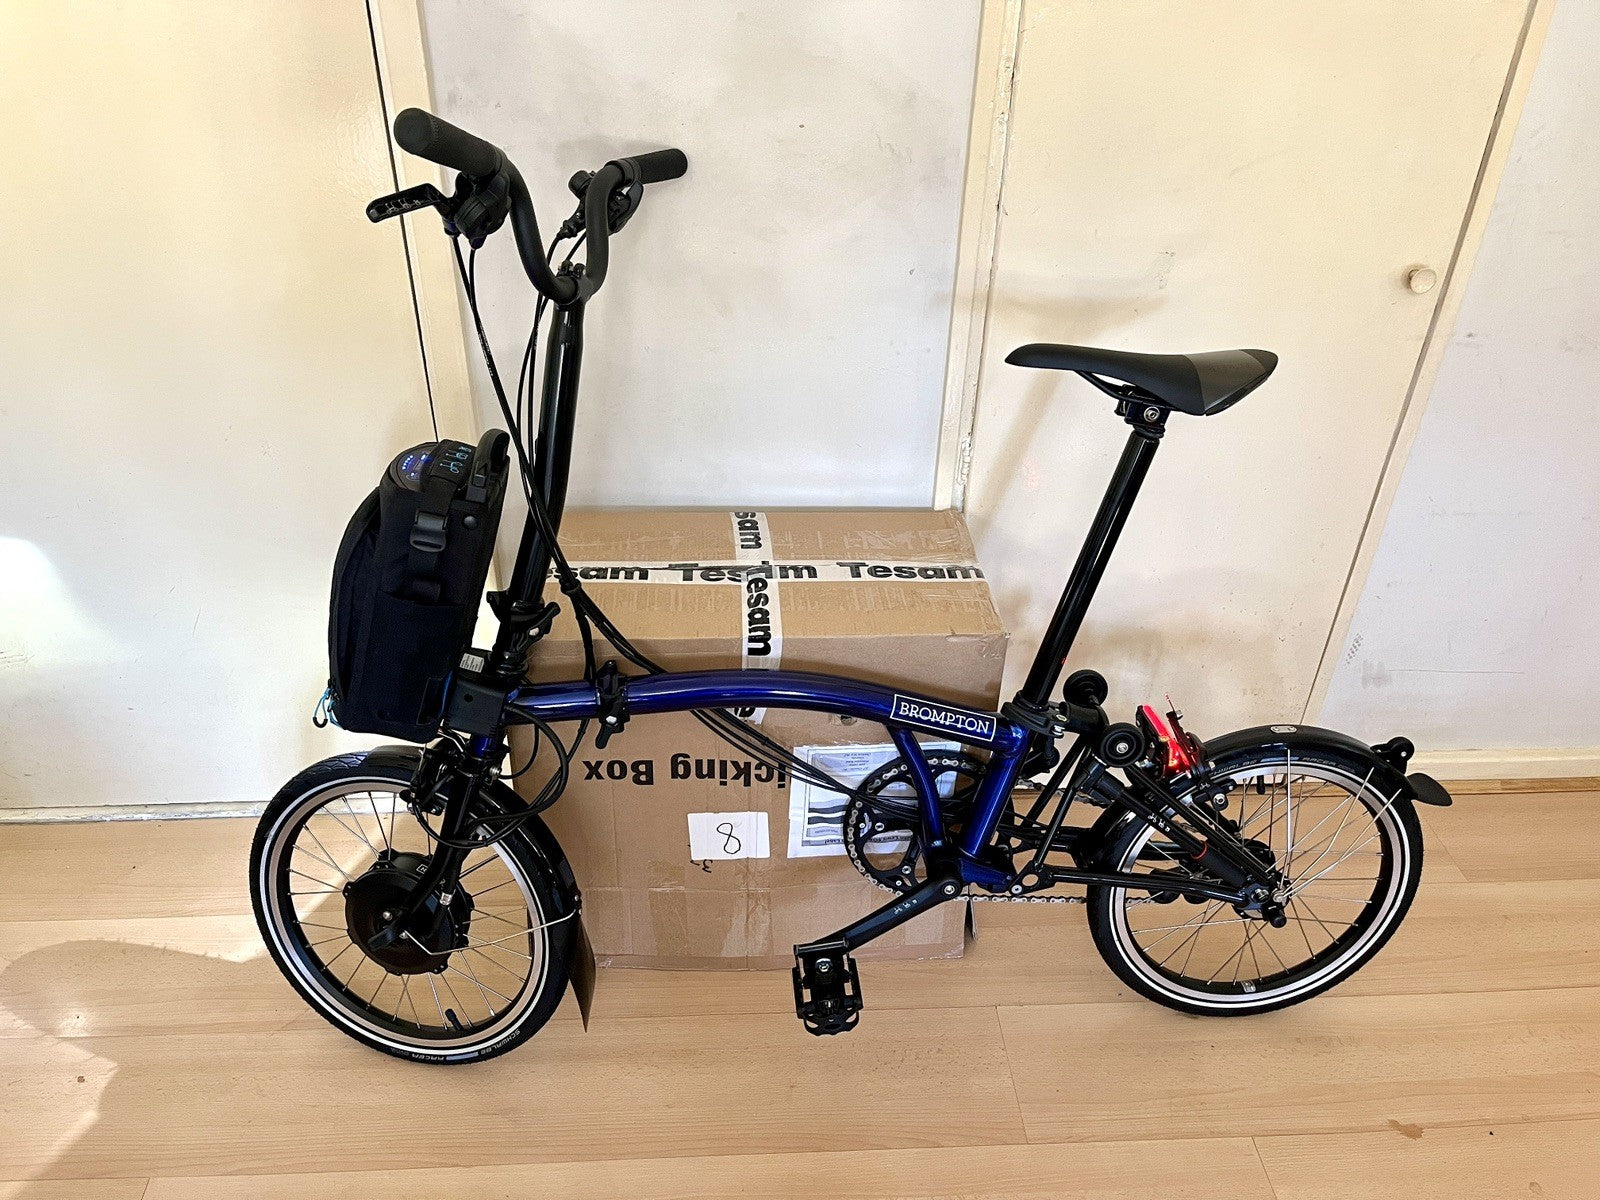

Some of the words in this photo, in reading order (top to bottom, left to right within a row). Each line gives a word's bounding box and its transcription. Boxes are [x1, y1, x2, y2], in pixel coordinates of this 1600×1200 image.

[668, 563, 818, 582] Tesm
[836, 562, 985, 579] Tesam
[746, 561, 773, 656] Tesam
[898, 702, 990, 734] BROMPTON
[582, 759, 655, 785] Box
[670, 753, 792, 788] icking
[716, 823, 742, 854] 8
[480, 1028, 521, 1055] SCHWALBE
[411, 1053, 445, 1061] RACER
